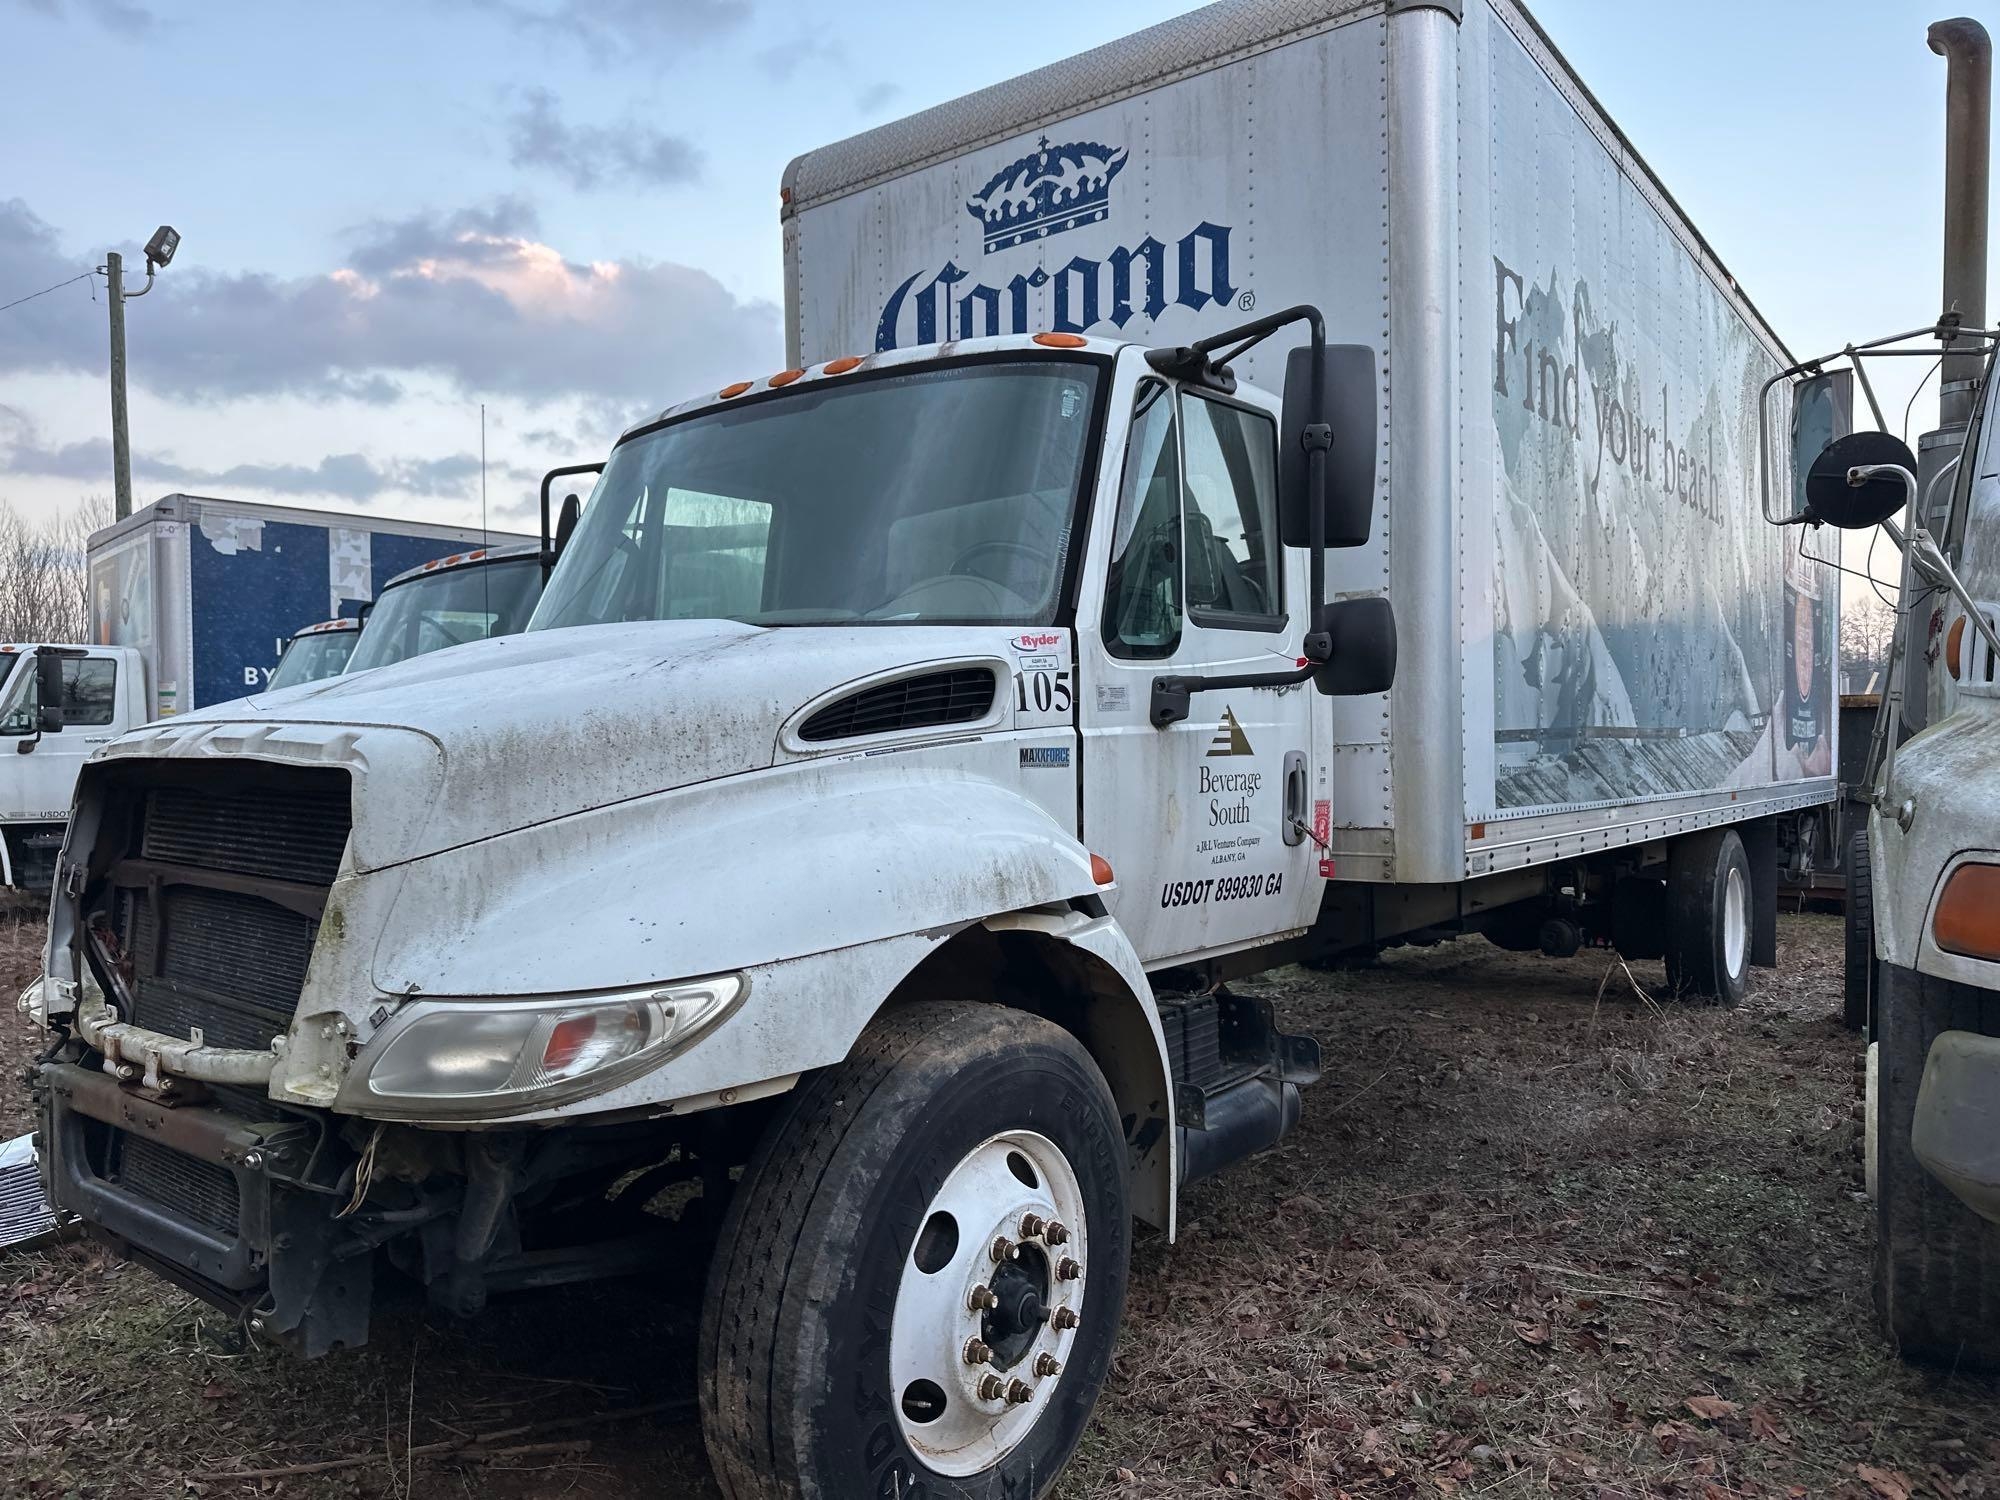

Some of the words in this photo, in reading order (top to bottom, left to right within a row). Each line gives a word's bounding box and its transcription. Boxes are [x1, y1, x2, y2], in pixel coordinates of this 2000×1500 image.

[875, 221, 1239, 353] Corona
[1494, 255, 1583, 441] Find
[1591, 382, 1657, 495] your
[1021, 634, 1060, 648] Ryder
[1013, 671, 1072, 712] 105
[1020, 747, 1070, 763] MAXXFORCE
[1199, 765, 1262, 797] Beverage
[1208, 797, 1250, 827] South
[1200, 840, 1212, 853] J&L
[1213, 839, 1236, 849] Ventures
[1236, 836, 1261, 848] Company
[1211, 853, 1237, 864] ALBANY,
[1237, 852, 1246, 861] GA
[1161, 879, 1214, 908] USDOT
[1215, 874, 1263, 902] 899830
[1265, 872, 1283, 896] GA
